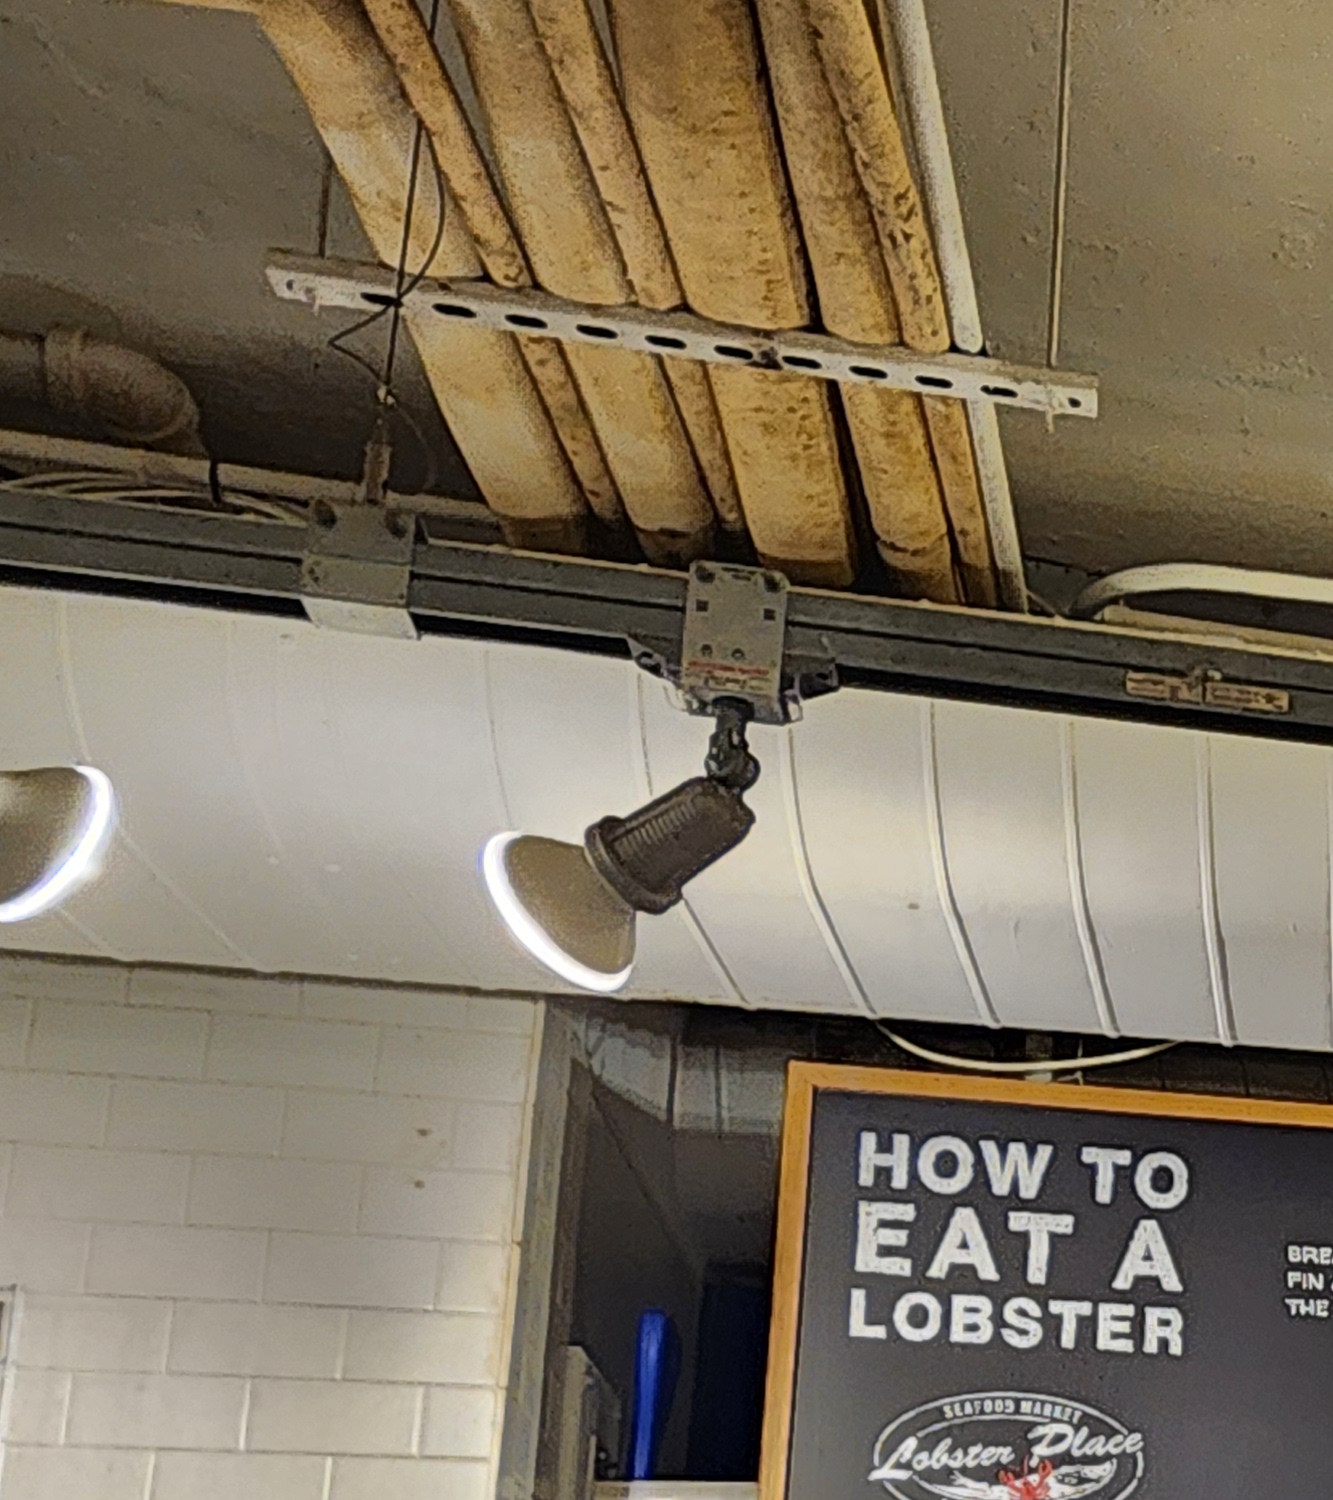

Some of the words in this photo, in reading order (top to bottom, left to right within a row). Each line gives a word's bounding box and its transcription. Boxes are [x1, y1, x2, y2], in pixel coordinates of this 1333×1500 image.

[857, 1131, 1053, 1199] HOW
[1080, 1146, 1189, 1209] TO
[854, 1200, 1075, 1285] EAT
[1111, 1219, 1184, 1291] A
[1286, 1298, 1329, 1318] THE
[1287, 1271, 1325, 1291] FIN
[848, 1288, 1184, 1356] LOBSTER
[943, 1399, 1016, 1419] SEAFOOD
[1019, 1400, 1083, 1424] MARKET
[867, 1436, 1016, 1481] Lobster
[1027, 1423, 1144, 1467] Place
